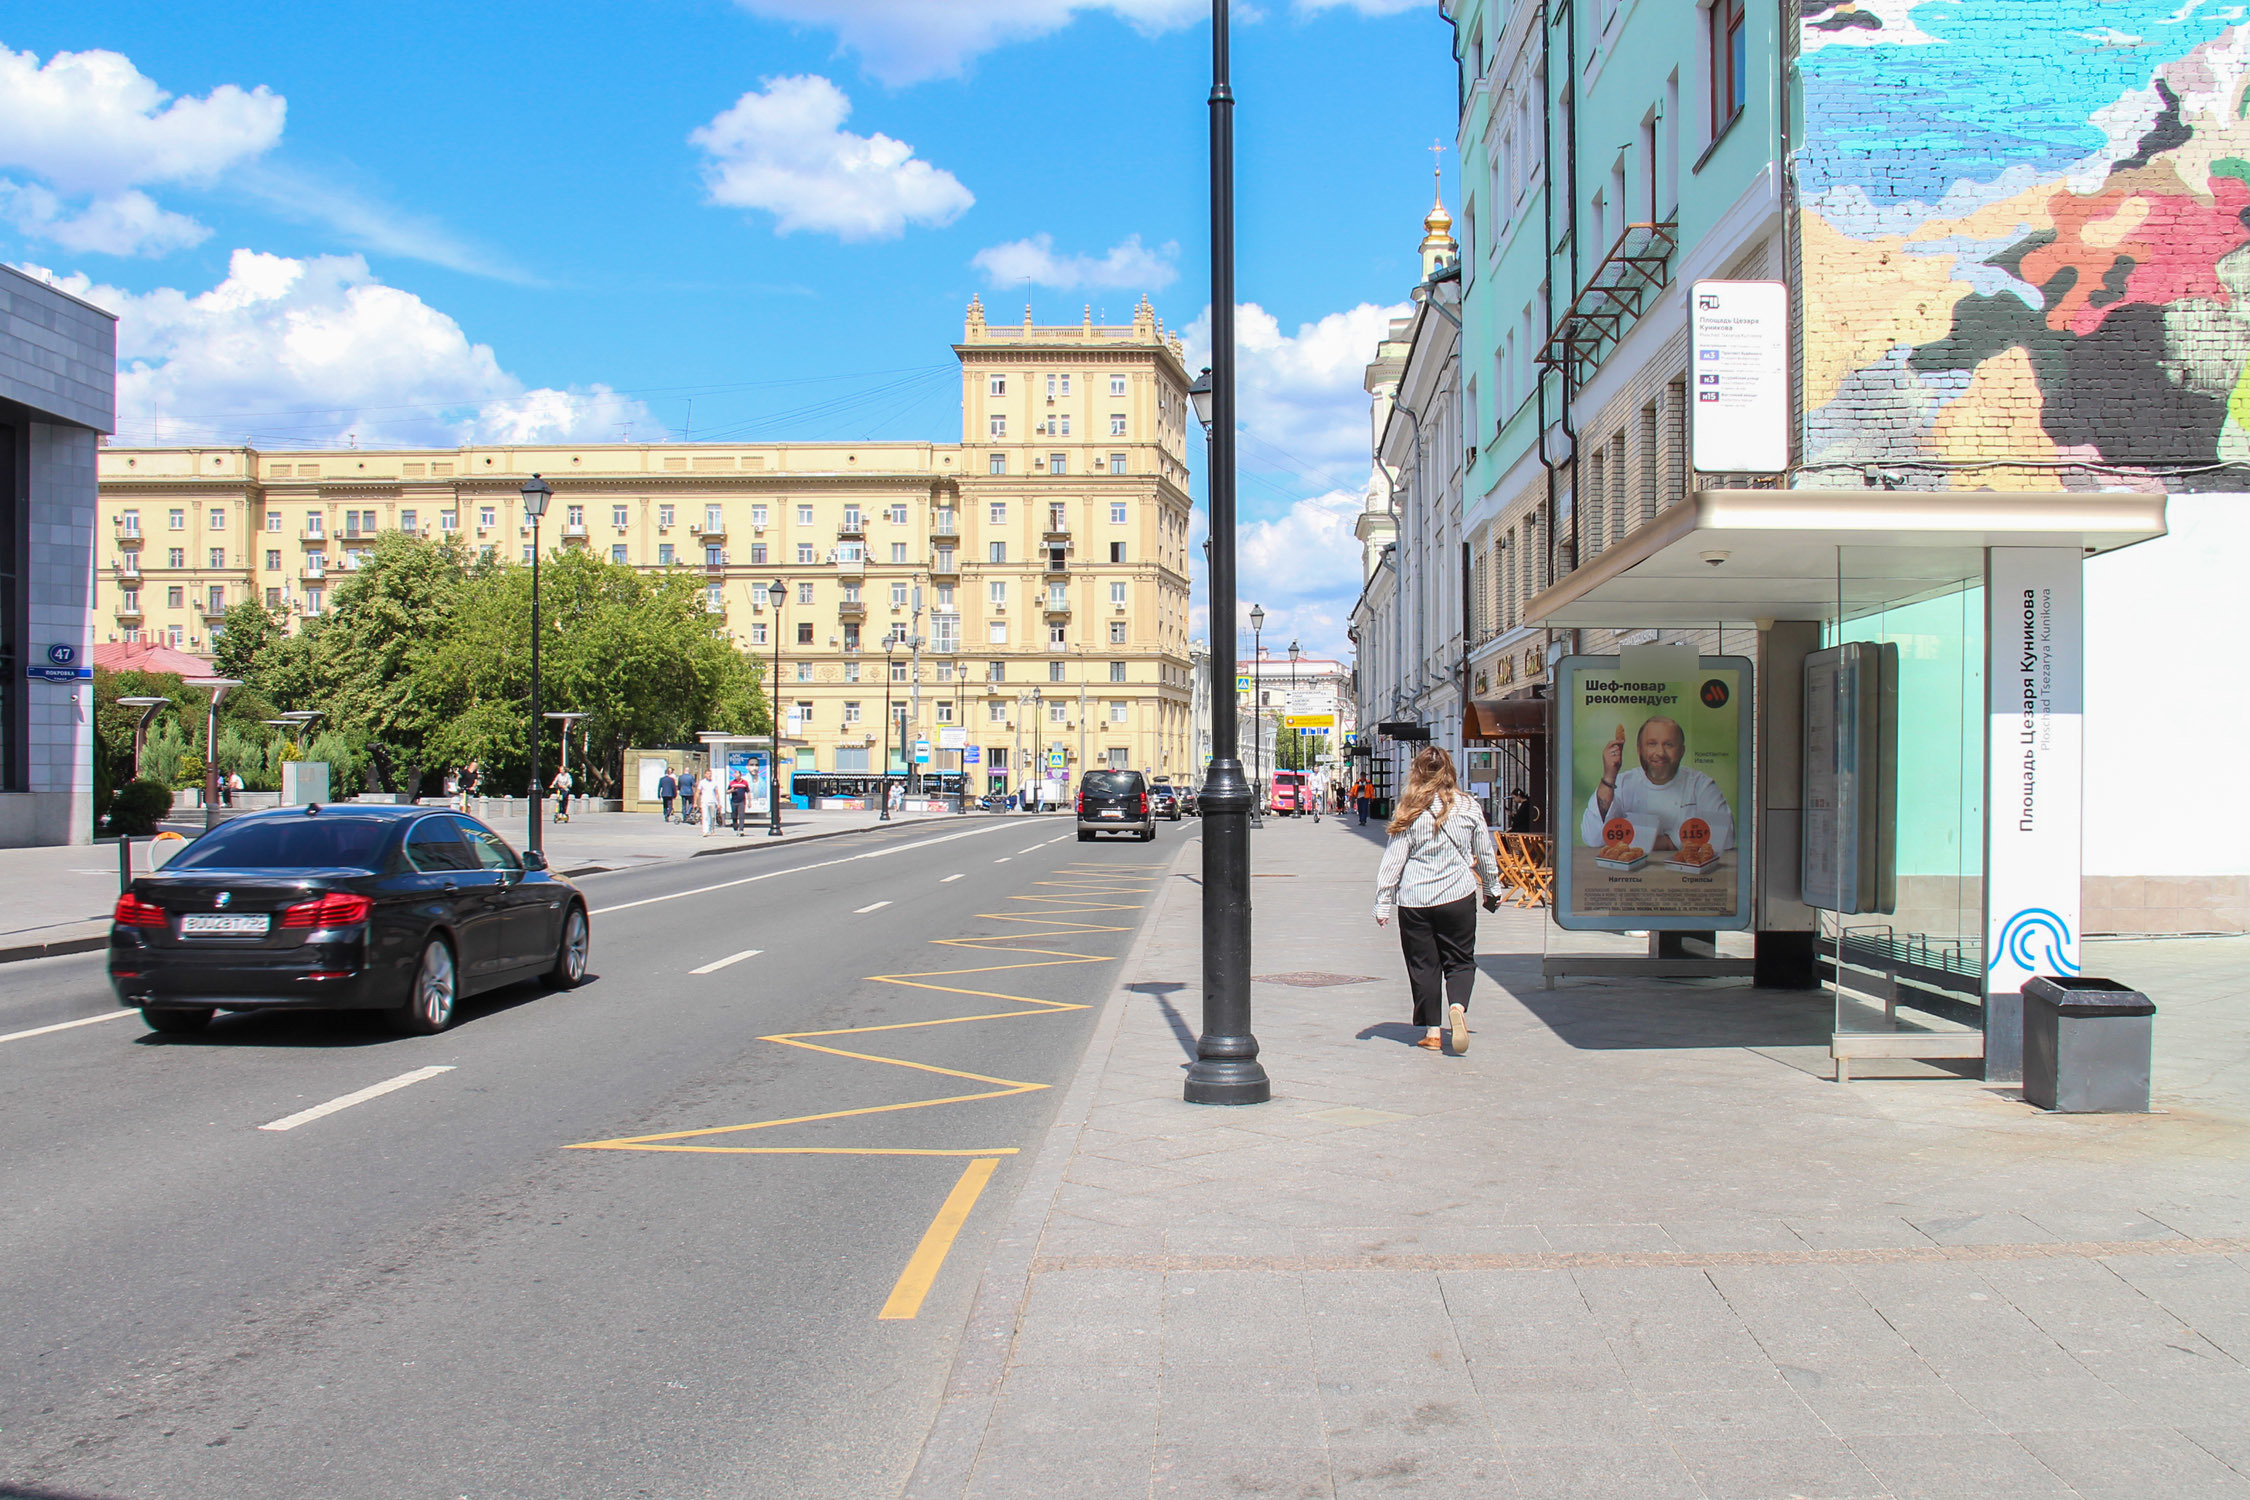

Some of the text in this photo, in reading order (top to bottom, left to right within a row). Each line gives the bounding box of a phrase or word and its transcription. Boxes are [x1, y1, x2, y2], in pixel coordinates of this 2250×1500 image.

[55, 649, 71, 660] 47
[2040, 589, 2052, 750] Ploschad Tsezarya Kunikova
[1586, 680, 1665, 693] Шеф-повар
[1586, 695, 1678, 706] рекомендует
[2020, 589, 2038, 831] Площадь Цезаря Куникова
[1681, 876, 1713, 884] Стрипсы
